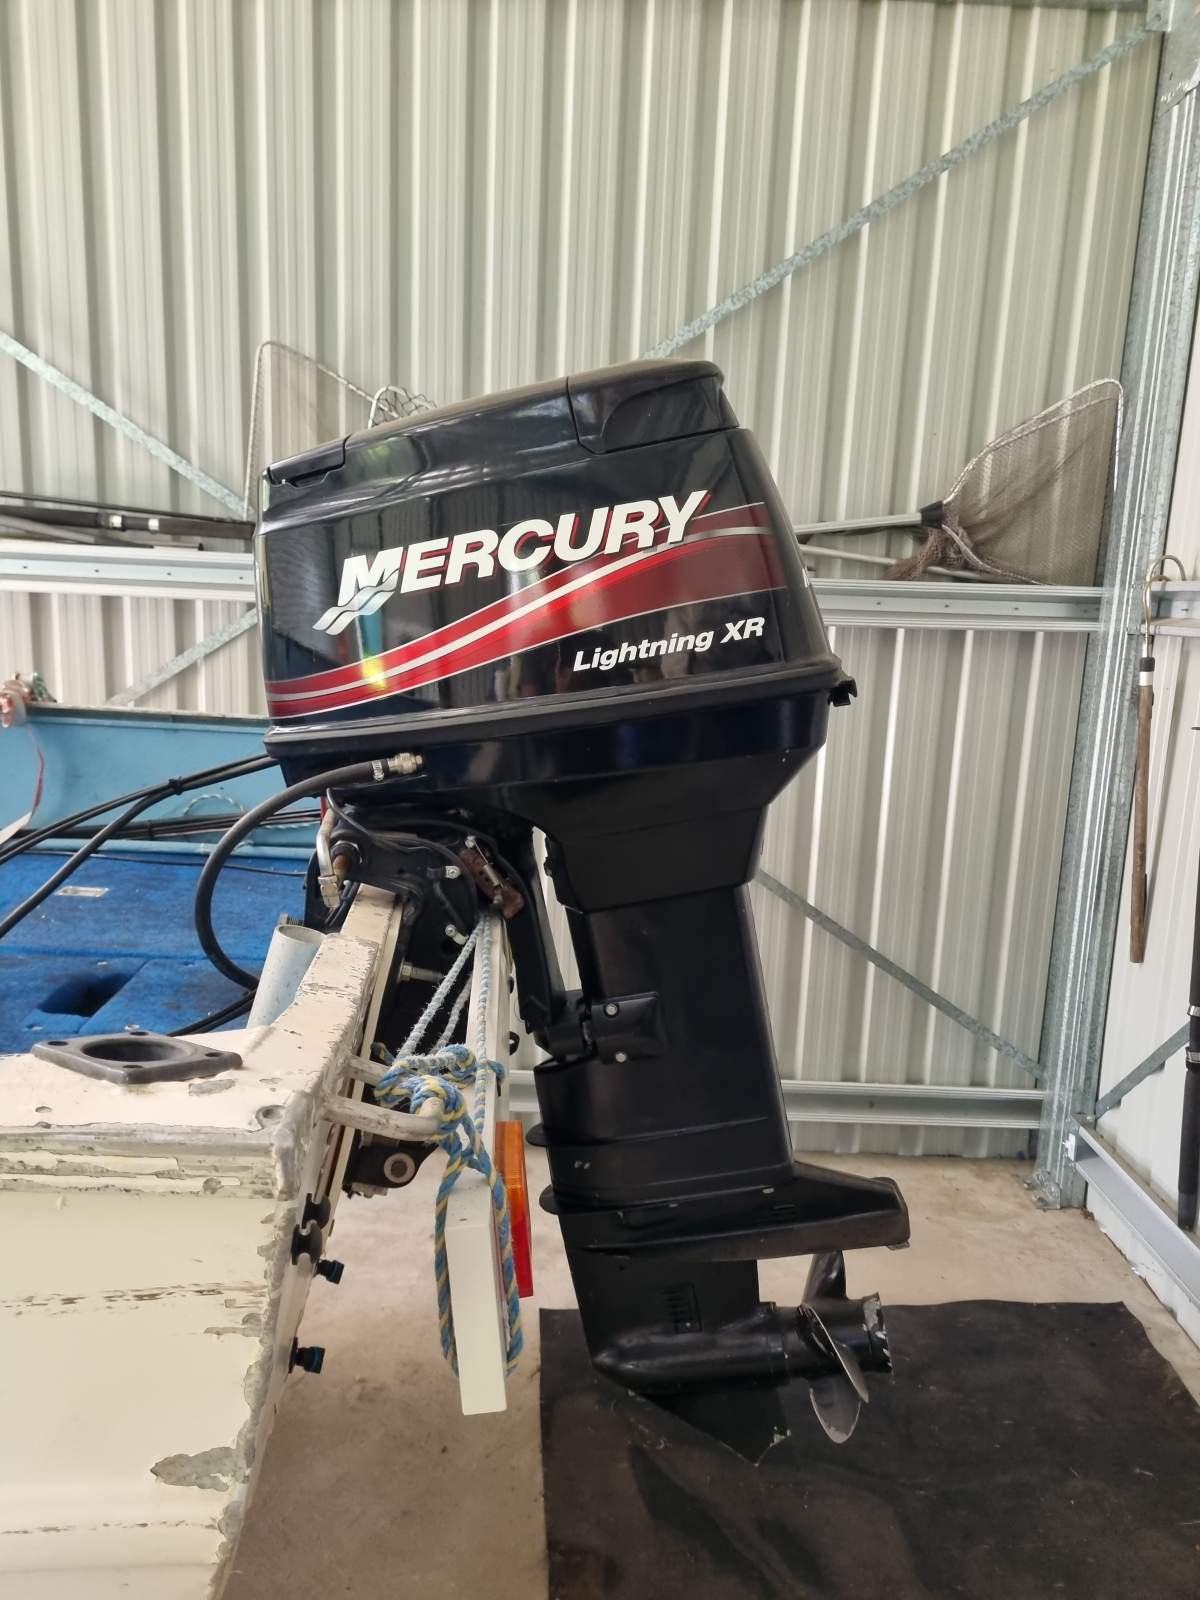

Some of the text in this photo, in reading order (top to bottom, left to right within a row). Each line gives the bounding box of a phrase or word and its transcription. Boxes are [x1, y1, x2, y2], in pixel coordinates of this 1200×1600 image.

[337, 490, 709, 607] MERCURY
[573, 617, 765, 672] Lightning XR
